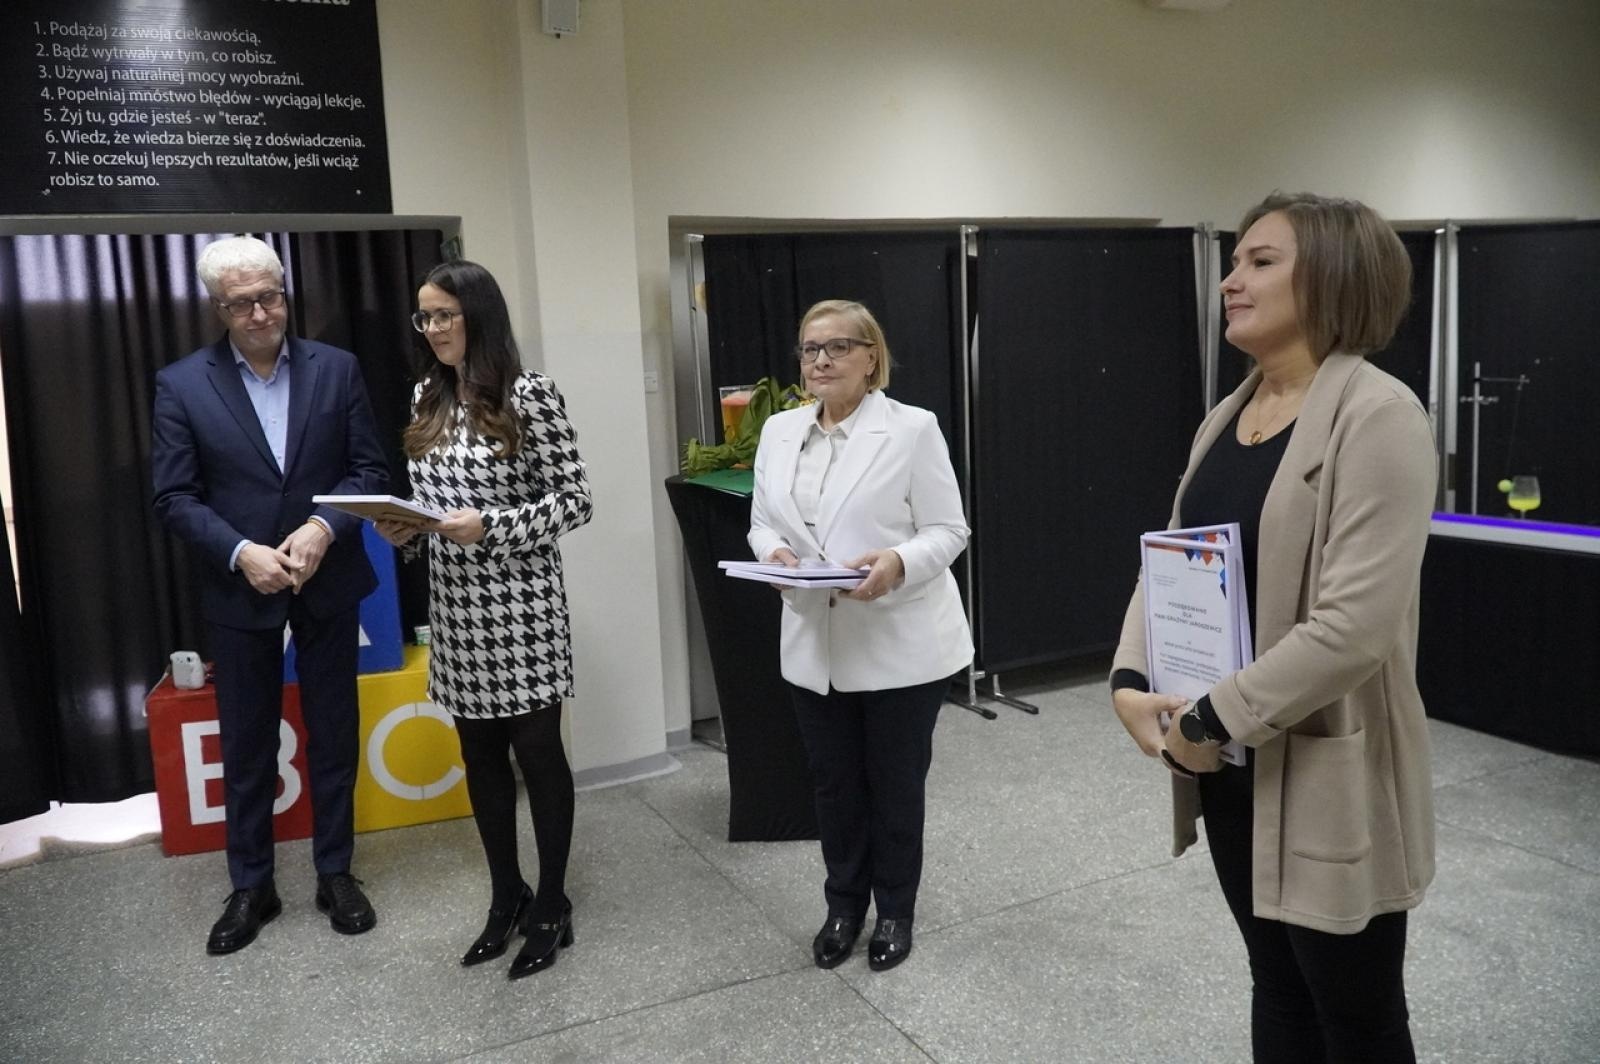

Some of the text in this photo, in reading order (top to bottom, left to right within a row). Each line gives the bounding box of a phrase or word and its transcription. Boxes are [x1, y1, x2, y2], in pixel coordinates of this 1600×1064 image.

[34, 21, 261, 46] 1. Podążaj za swoją ciekawością.
[35, 43, 276, 64] 2. Bądź wytrwały w tym, co robisz.
[38, 65, 304, 86] 3. Używaj naturalnej mocy wyobraźni.
[41, 87, 54, 100] 4.
[58, 86, 126, 104] Popełniaj
[130, 88, 196, 103] mnóstwo
[200, 90, 251, 107] błędów
[263, 93, 321, 110] wyciągaj
[325, 94, 366, 110] lekcje.
[44, 109, 56, 122] 5.
[60, 106, 82, 125] Żyj
[86, 110, 106, 124] tu,
[109, 110, 148, 126] gdzie
[151, 110, 192, 126] jesteś
[204, 115, 216, 124] w
[46, 130, 366, 148] 6. Wiedz, że wiedza bierze się z doświadczenia.
[48, 152, 359, 170] 7. Nie oczekuj lepszych rezultatów, jeśli wciąż
[50, 172, 159, 186] robisz to samo.
[368, 702, 465, 800] C
